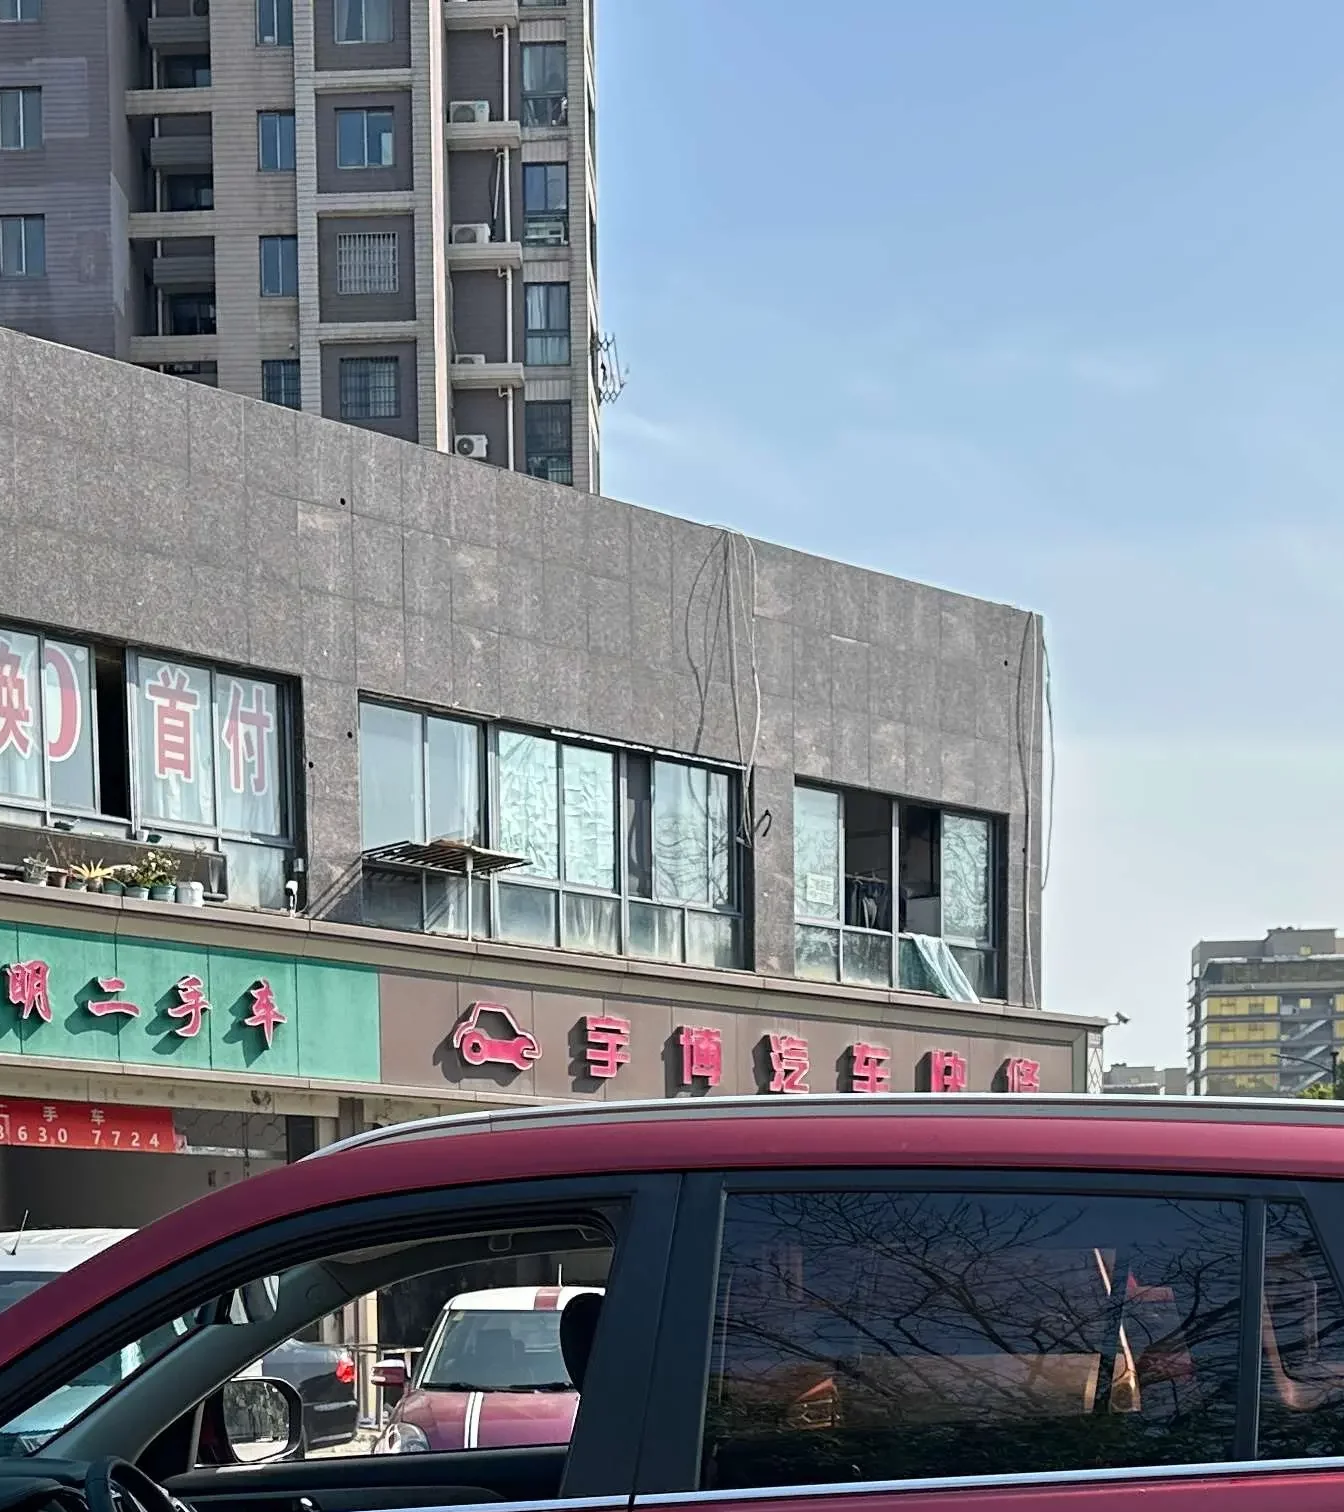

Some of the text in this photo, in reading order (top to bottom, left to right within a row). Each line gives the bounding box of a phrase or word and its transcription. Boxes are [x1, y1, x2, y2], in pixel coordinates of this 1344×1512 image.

[586, 1016, 1040, 1093] 宇博汽车快修
